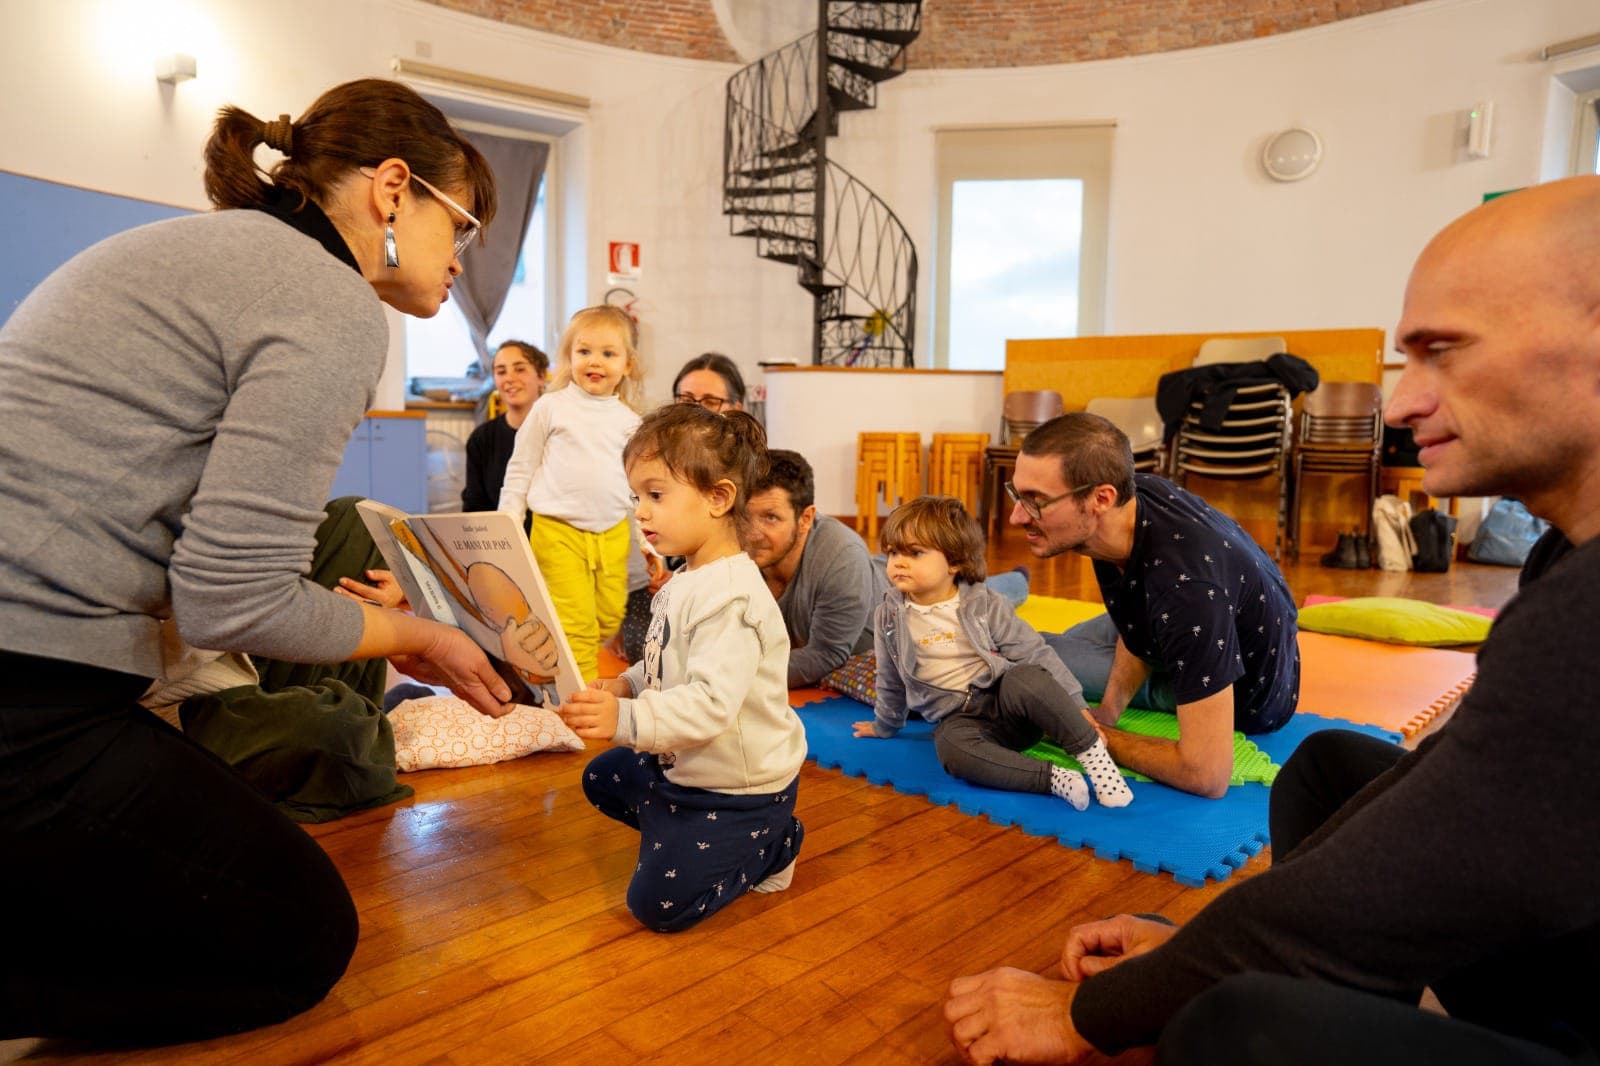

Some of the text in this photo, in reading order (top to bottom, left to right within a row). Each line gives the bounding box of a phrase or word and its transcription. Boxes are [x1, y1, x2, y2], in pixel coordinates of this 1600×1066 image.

[453, 540, 464, 550] LE
[463, 540, 482, 550] MANI
[482, 540, 492, 550] DI
